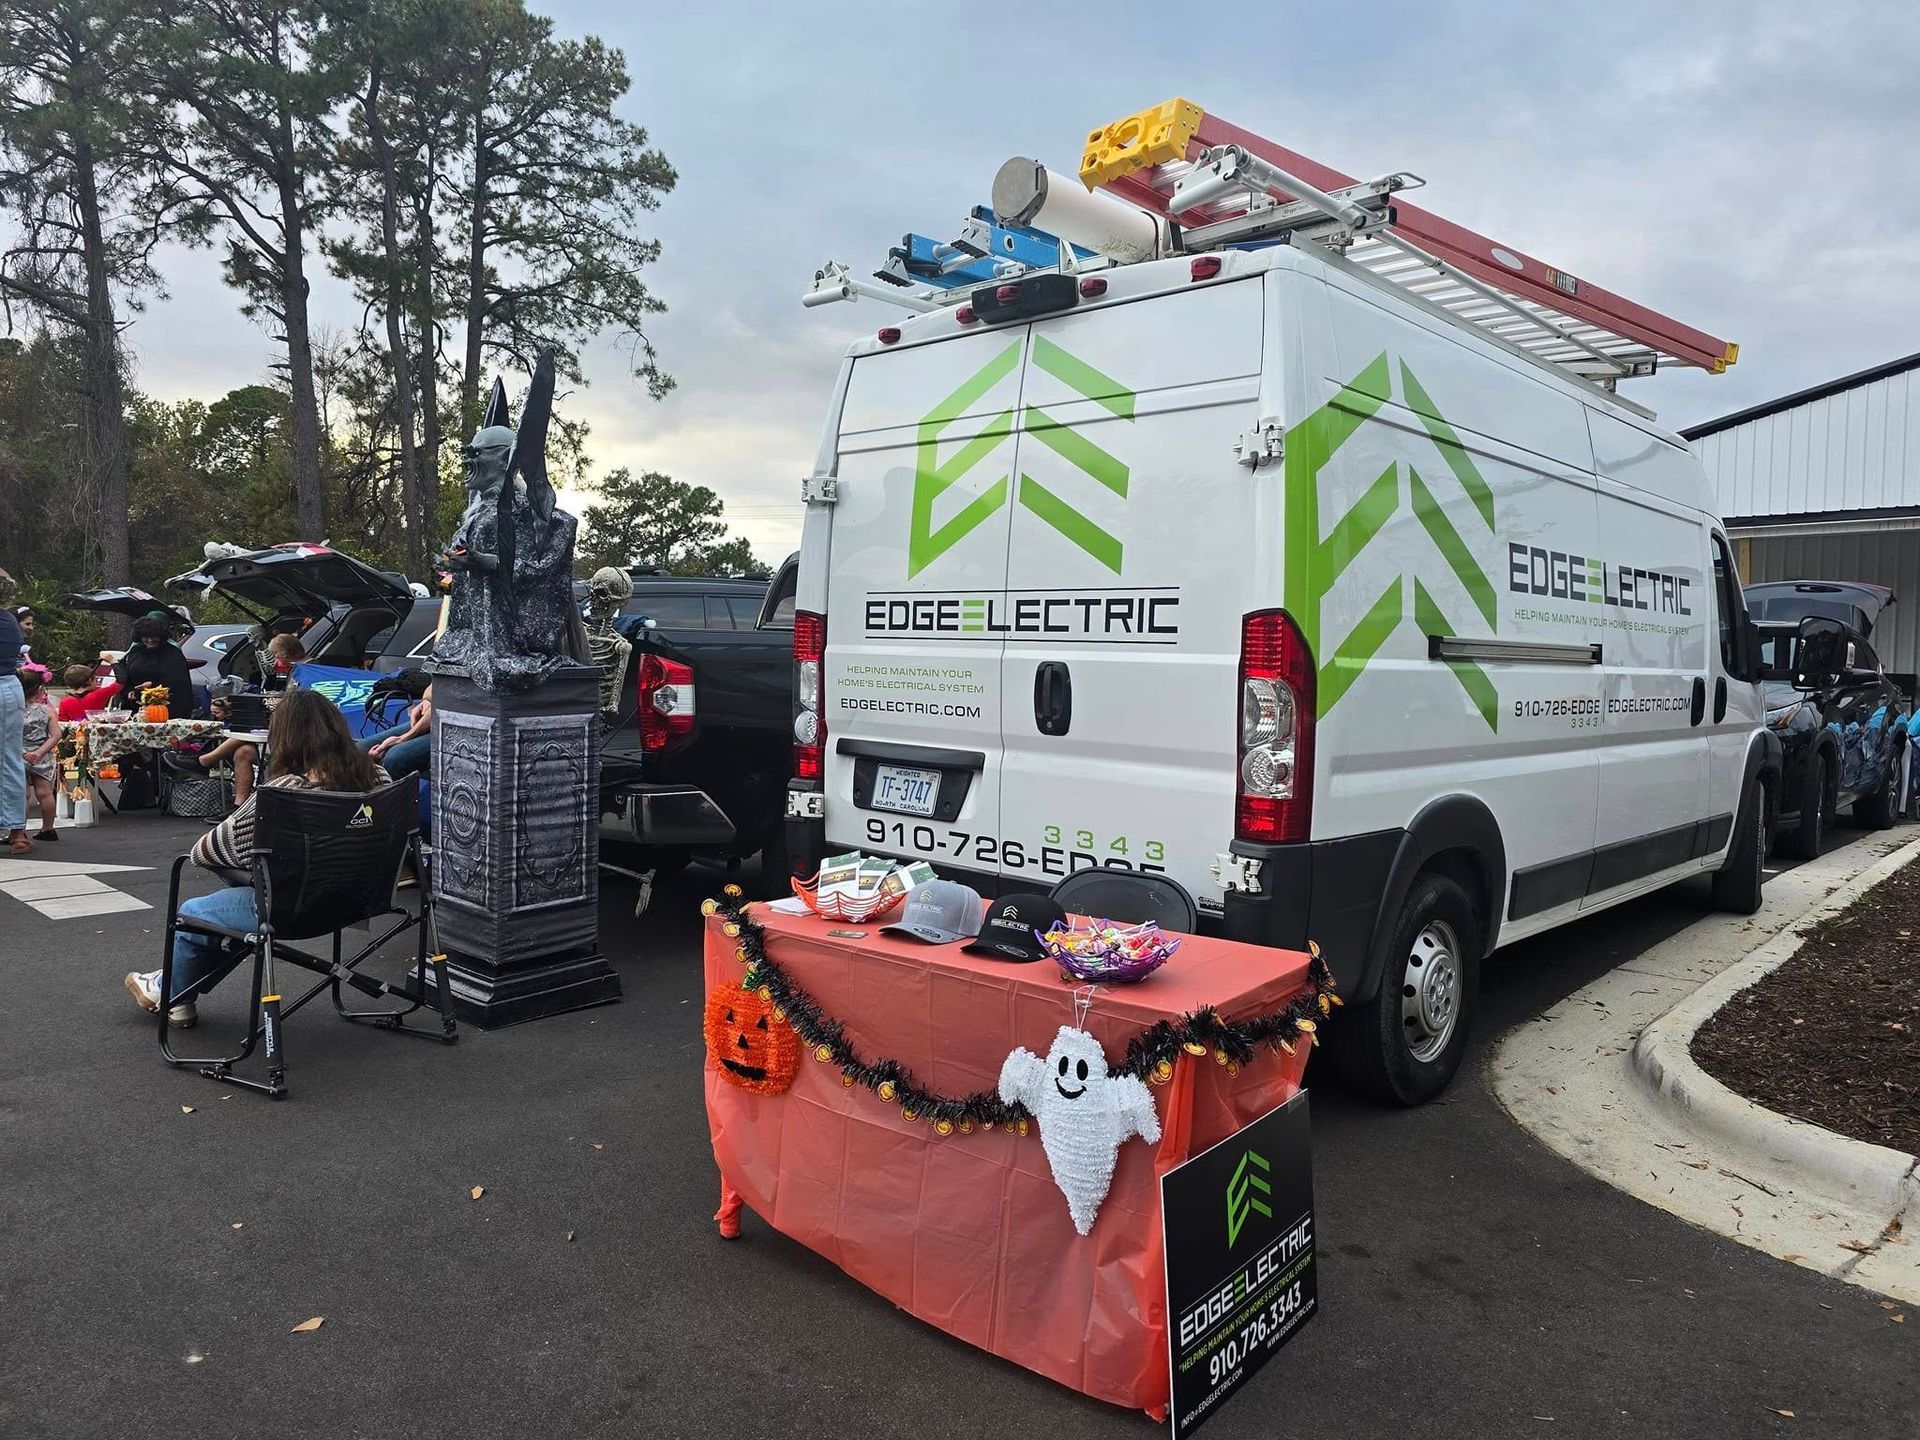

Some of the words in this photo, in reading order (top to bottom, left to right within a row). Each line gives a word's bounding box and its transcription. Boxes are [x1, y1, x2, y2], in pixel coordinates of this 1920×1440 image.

[1514, 608, 1550, 622] HELPING
[1551, 612, 1587, 626] MAINTAIN
[1588, 616, 1607, 628] YOUR
[1634, 622, 1667, 634] ELECTRICAL
[847, 665, 888, 675] HELPING
[889, 667, 940, 677] MAINTAIN
[941, 669, 972, 679] YOUR
[837, 678, 874, 688] HOME'S
[876, 680, 937, 691] ELECTRICAL
[938, 684, 984, 694] SYSTEM
[840, 697, 981, 718] EDGELECTRIC.COM
[1515, 699, 1600, 717] 910-726-EDGE
[1608, 697, 1691, 713] EDGELECTRIC.COM
[881, 776, 932, 804] TF-3747
[875, 800, 896, 808] NORTH
[866, 818, 1165, 877] 910-726-ED
[1207, 1322, 1235, 1350] MAINTAIN
[1235, 1308, 1250, 1327] YOUR
[1268, 1271, 1295, 1298] ELECTRICAL
[1209, 1280, 1301, 1386] 910.726.3343
